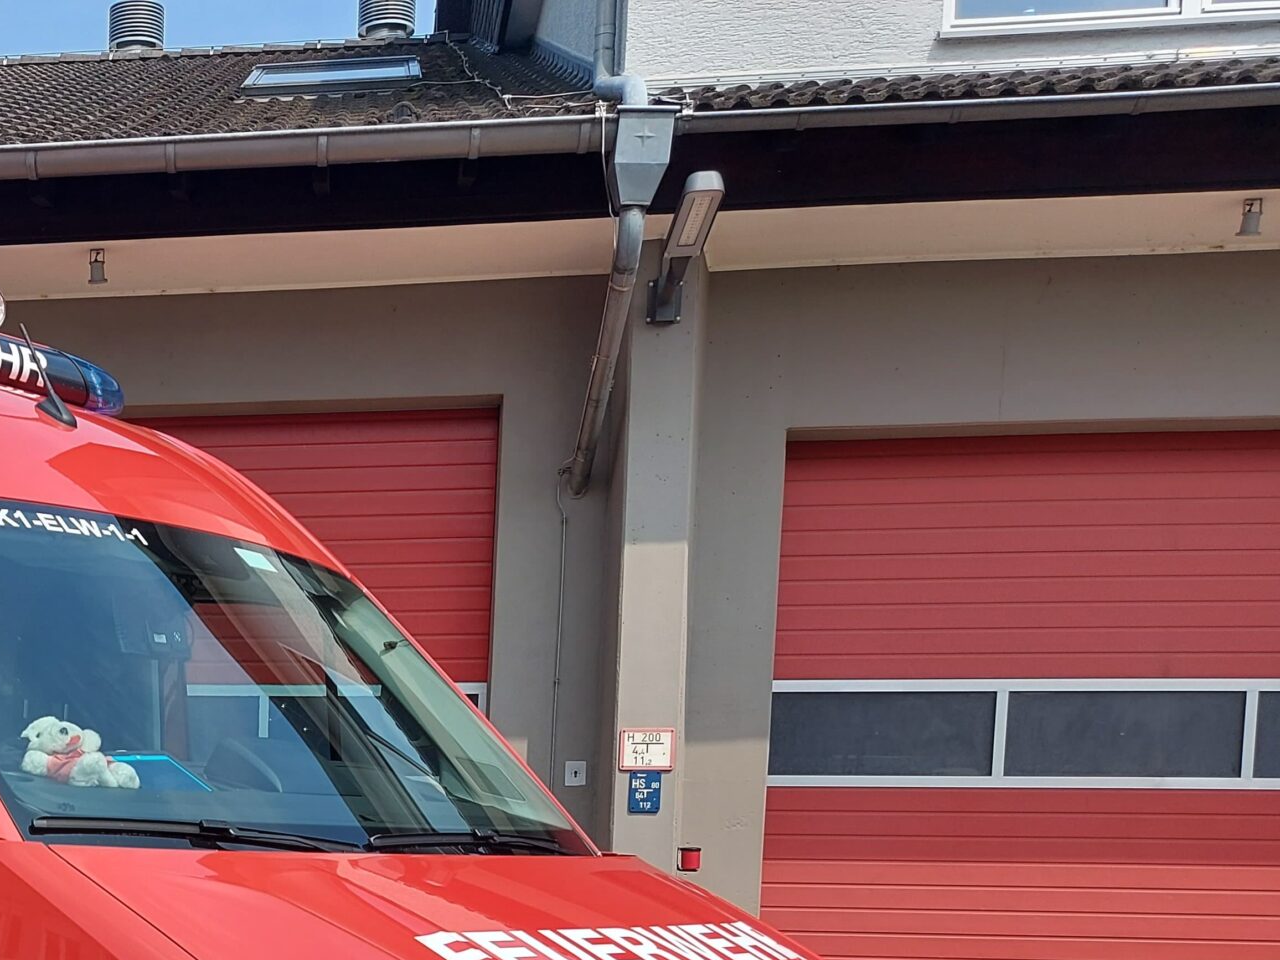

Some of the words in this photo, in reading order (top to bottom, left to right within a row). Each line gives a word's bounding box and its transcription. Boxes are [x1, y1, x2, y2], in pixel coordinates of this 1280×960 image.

[627, 733, 635, 742] H
[641, 732, 661, 742] 200
[631, 778, 646, 789] HS
